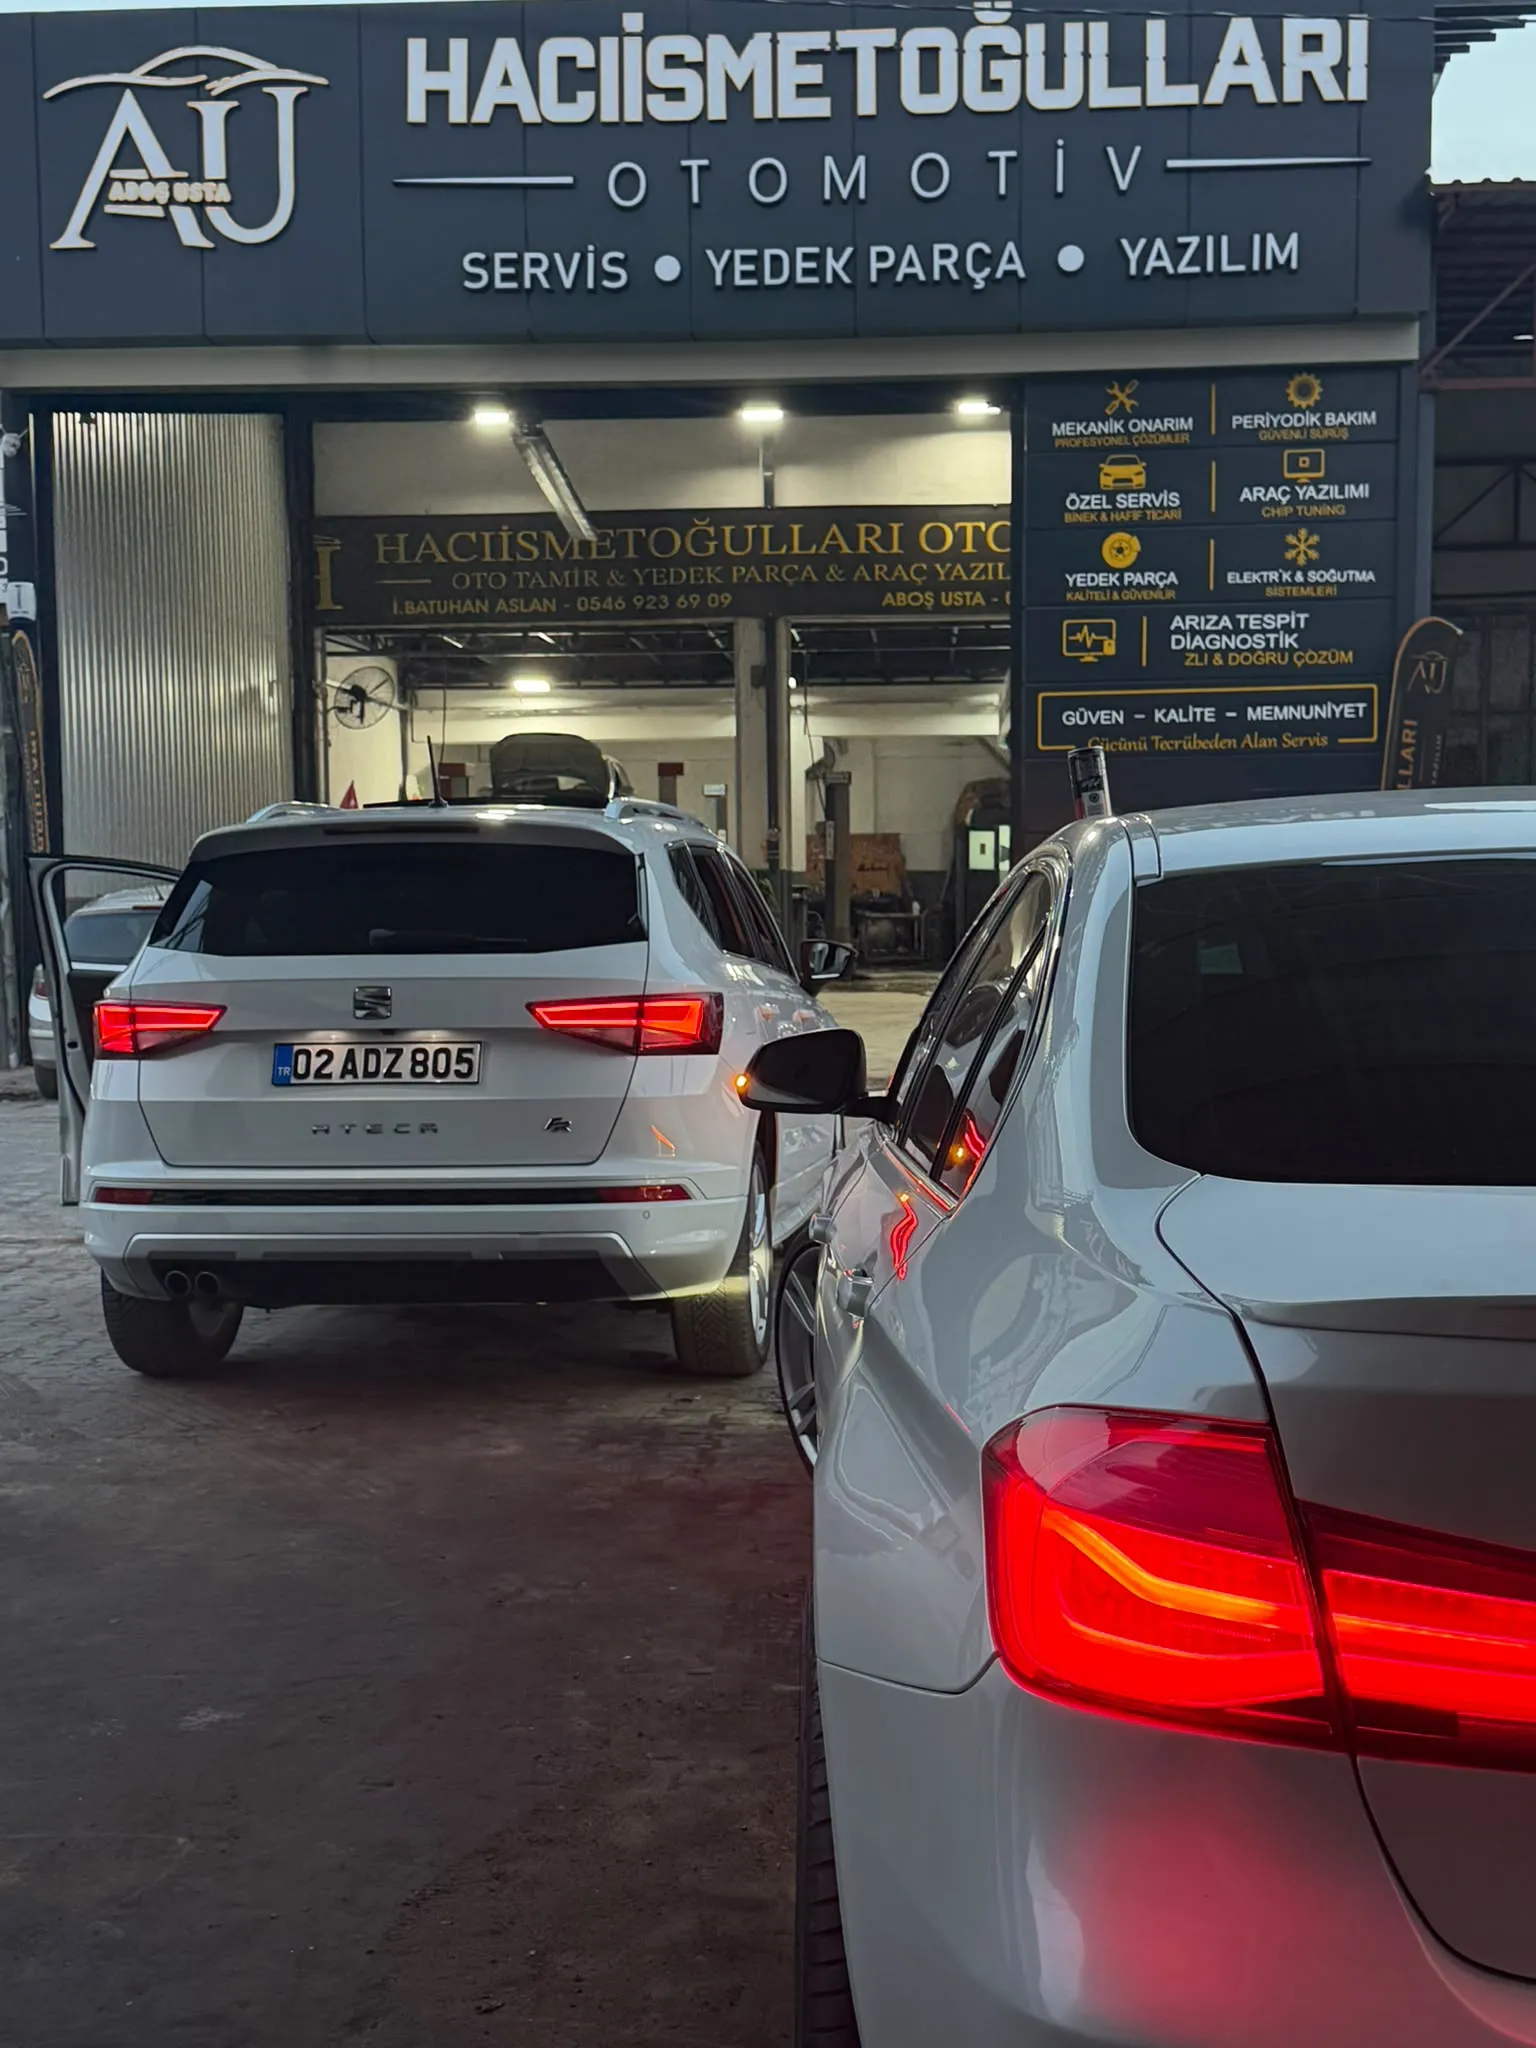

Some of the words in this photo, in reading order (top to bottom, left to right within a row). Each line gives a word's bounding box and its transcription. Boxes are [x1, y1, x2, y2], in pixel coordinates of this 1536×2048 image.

[406, 0, 1368, 124] HACIİSMETOĞULLARI
[607, 139, 1143, 208] OTOMOTİV
[172, 182, 232, 203] USTA
[462, 244, 629, 291] SERVİS
[705, 245, 854, 288] YEDEK
[868, 241, 1026, 289] PARÇA
[1120, 232, 1299, 278] YAZILIM
[1052, 417, 1125, 436] MEKANİK
[1128, 417, 1193, 433] ONARIM
[1232, 410, 1321, 429] PERİYODİK
[1324, 411, 1376, 425] BAKIM
[1065, 492, 1112, 511] ÖZEL
[1116, 490, 1180, 509] SERVİS
[1240, 486, 1291, 505] ARAÇ
[1295, 483, 1370, 501] YAZILIMI
[452, 571, 507, 590] OTO
[513, 566, 600, 588] TAMİR
[606, 568, 627, 587] &
[632, 566, 724, 586] YEDEK
[731, 564, 819, 586] PARÇA
[825, 563, 846, 582] &
[852, 563, 928, 585] ARAÇ
[1065, 572, 1120, 587] YEDEK
[1123, 571, 1179, 588] PARÇA
[1294, 569, 1304, 583] &
[1307, 568, 1376, 583] SOĞUTMA
[881, 591, 935, 610] ABOŞ
[940, 591, 986, 607] USTA
[1264, 584, 1337, 597] SİSTEMLERİ
[495, 598, 556, 614] ASLAN
[577, 596, 626, 611] 0546
[633, 594, 669, 610] 923
[676, 593, 700, 608] 69
[707, 592, 733, 608] 09
[1169, 614, 1233, 631] ARIZA
[1235, 610, 1310, 630] TESPİT
[1170, 630, 1299, 650] DİAGNOSTİK
[1212, 652, 1224, 666] &
[1228, 650, 1288, 666] DOĞRU
[1293, 648, 1353, 668] ÇÖZÜM
[1062, 707, 1125, 725] GÜVEN
[1154, 705, 1216, 723] KALİTE
[1246, 700, 1368, 721] MEMNUNİYET
[1150, 733, 1240, 751] Tecrübeden
[1242, 731, 1280, 749] Alan
[1281, 731, 1329, 748] Servis
[277, 1067, 291, 1077] TR
[293, 1048, 335, 1081] 02
[339, 1047, 405, 1081] ADZ
[410, 1047, 475, 1080] 805
